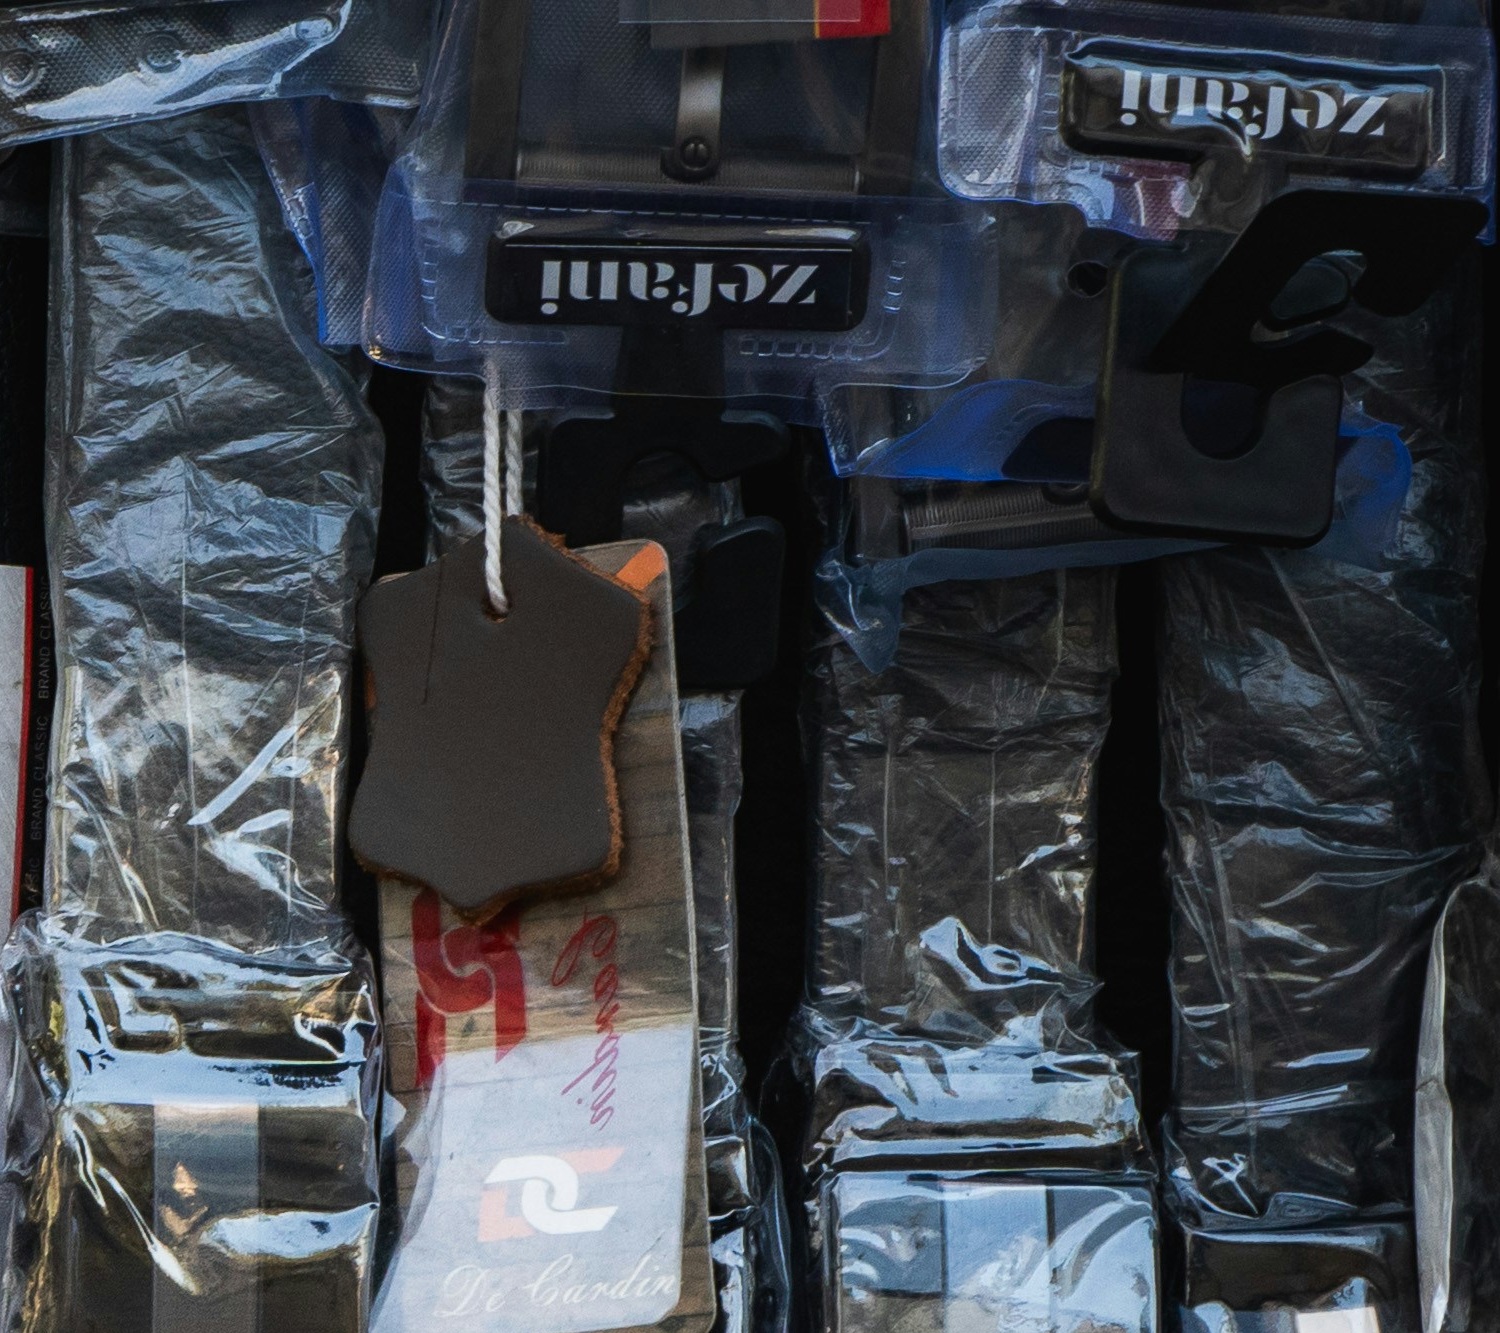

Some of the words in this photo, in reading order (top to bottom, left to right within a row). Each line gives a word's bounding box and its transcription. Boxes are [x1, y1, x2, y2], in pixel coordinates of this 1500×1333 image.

[1119, 69, 1389, 143] zefani
[540, 261, 819, 316] zefani
[37, 647, 51, 699] BRAND
[32, 715, 50, 781] CLASSIC
